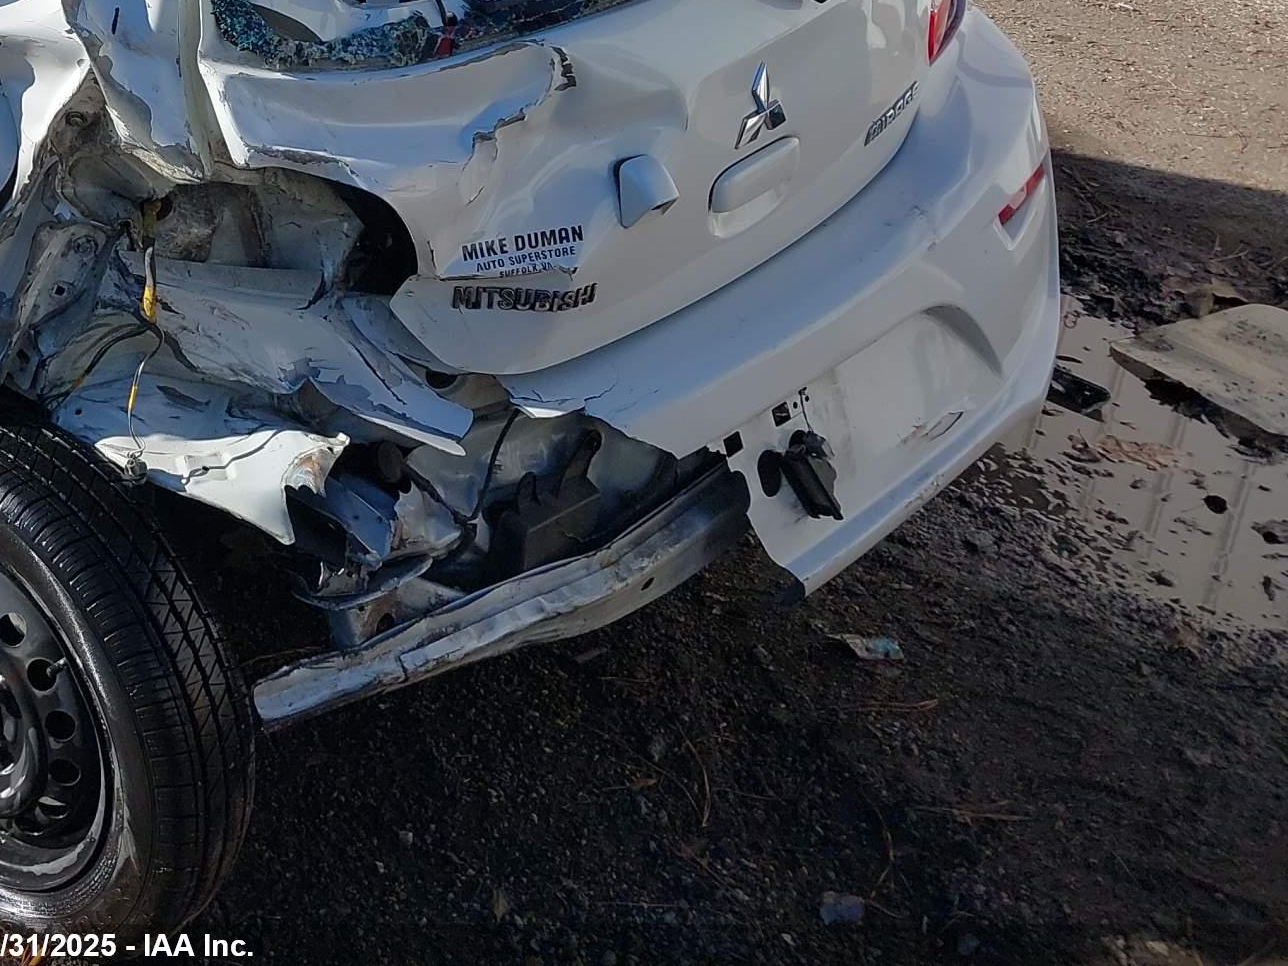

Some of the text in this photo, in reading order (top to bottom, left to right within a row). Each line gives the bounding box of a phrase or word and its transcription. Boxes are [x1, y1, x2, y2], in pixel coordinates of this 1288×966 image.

[462, 225, 584, 262] MIKE DUMAN
[476, 246, 576, 273] AUTO SUPERSTORE
[452, 282, 598, 313] MITSUBISHI
